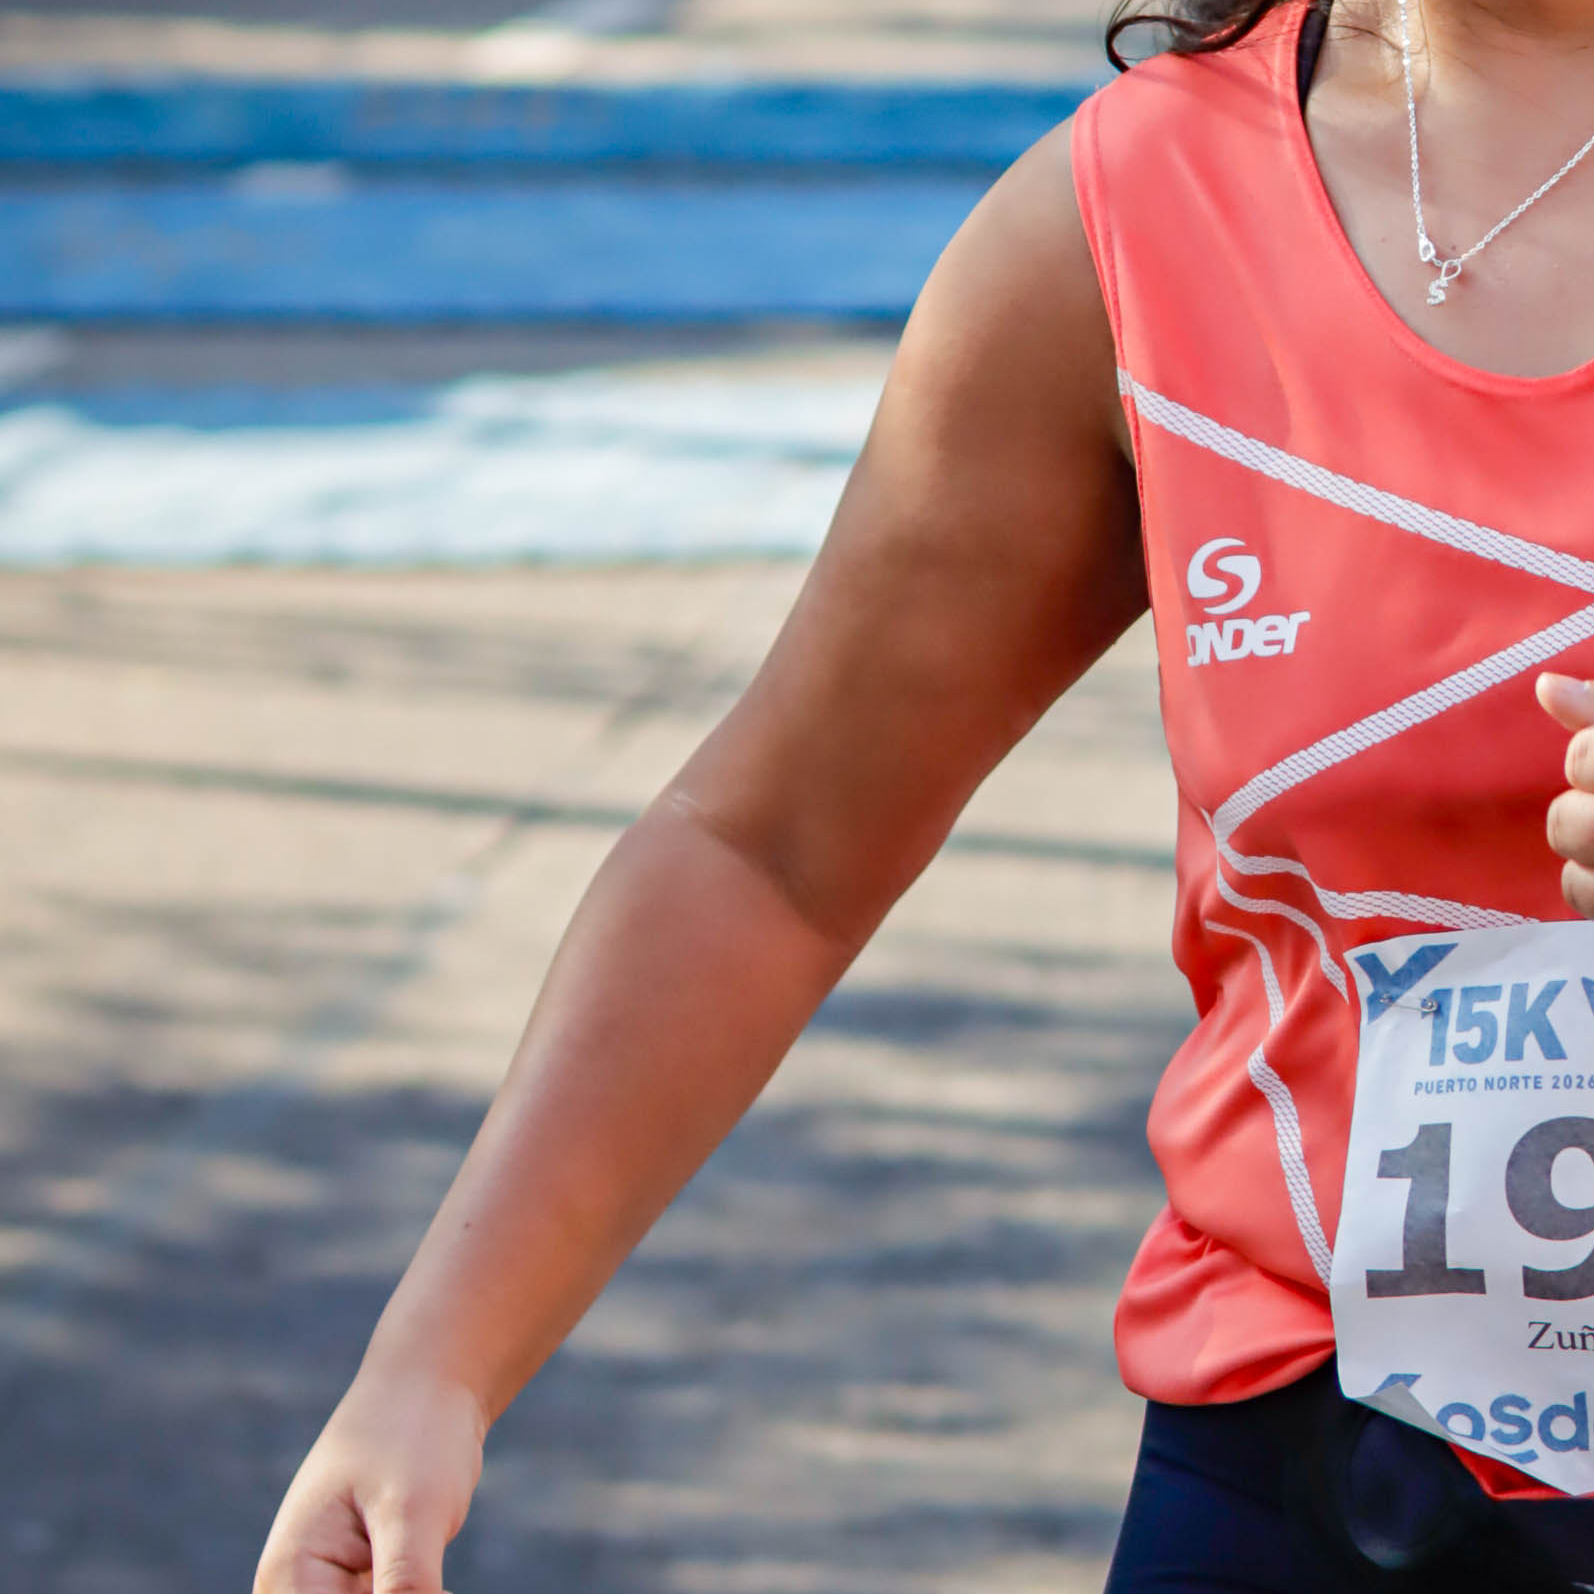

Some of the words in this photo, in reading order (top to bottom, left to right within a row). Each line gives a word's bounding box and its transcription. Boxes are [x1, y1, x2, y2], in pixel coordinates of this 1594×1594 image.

[1421, 979, 1568, 1067] 15K
[1414, 1075, 1477, 1095] PUERTO
[1484, 1074, 1543, 1091] NORTE
